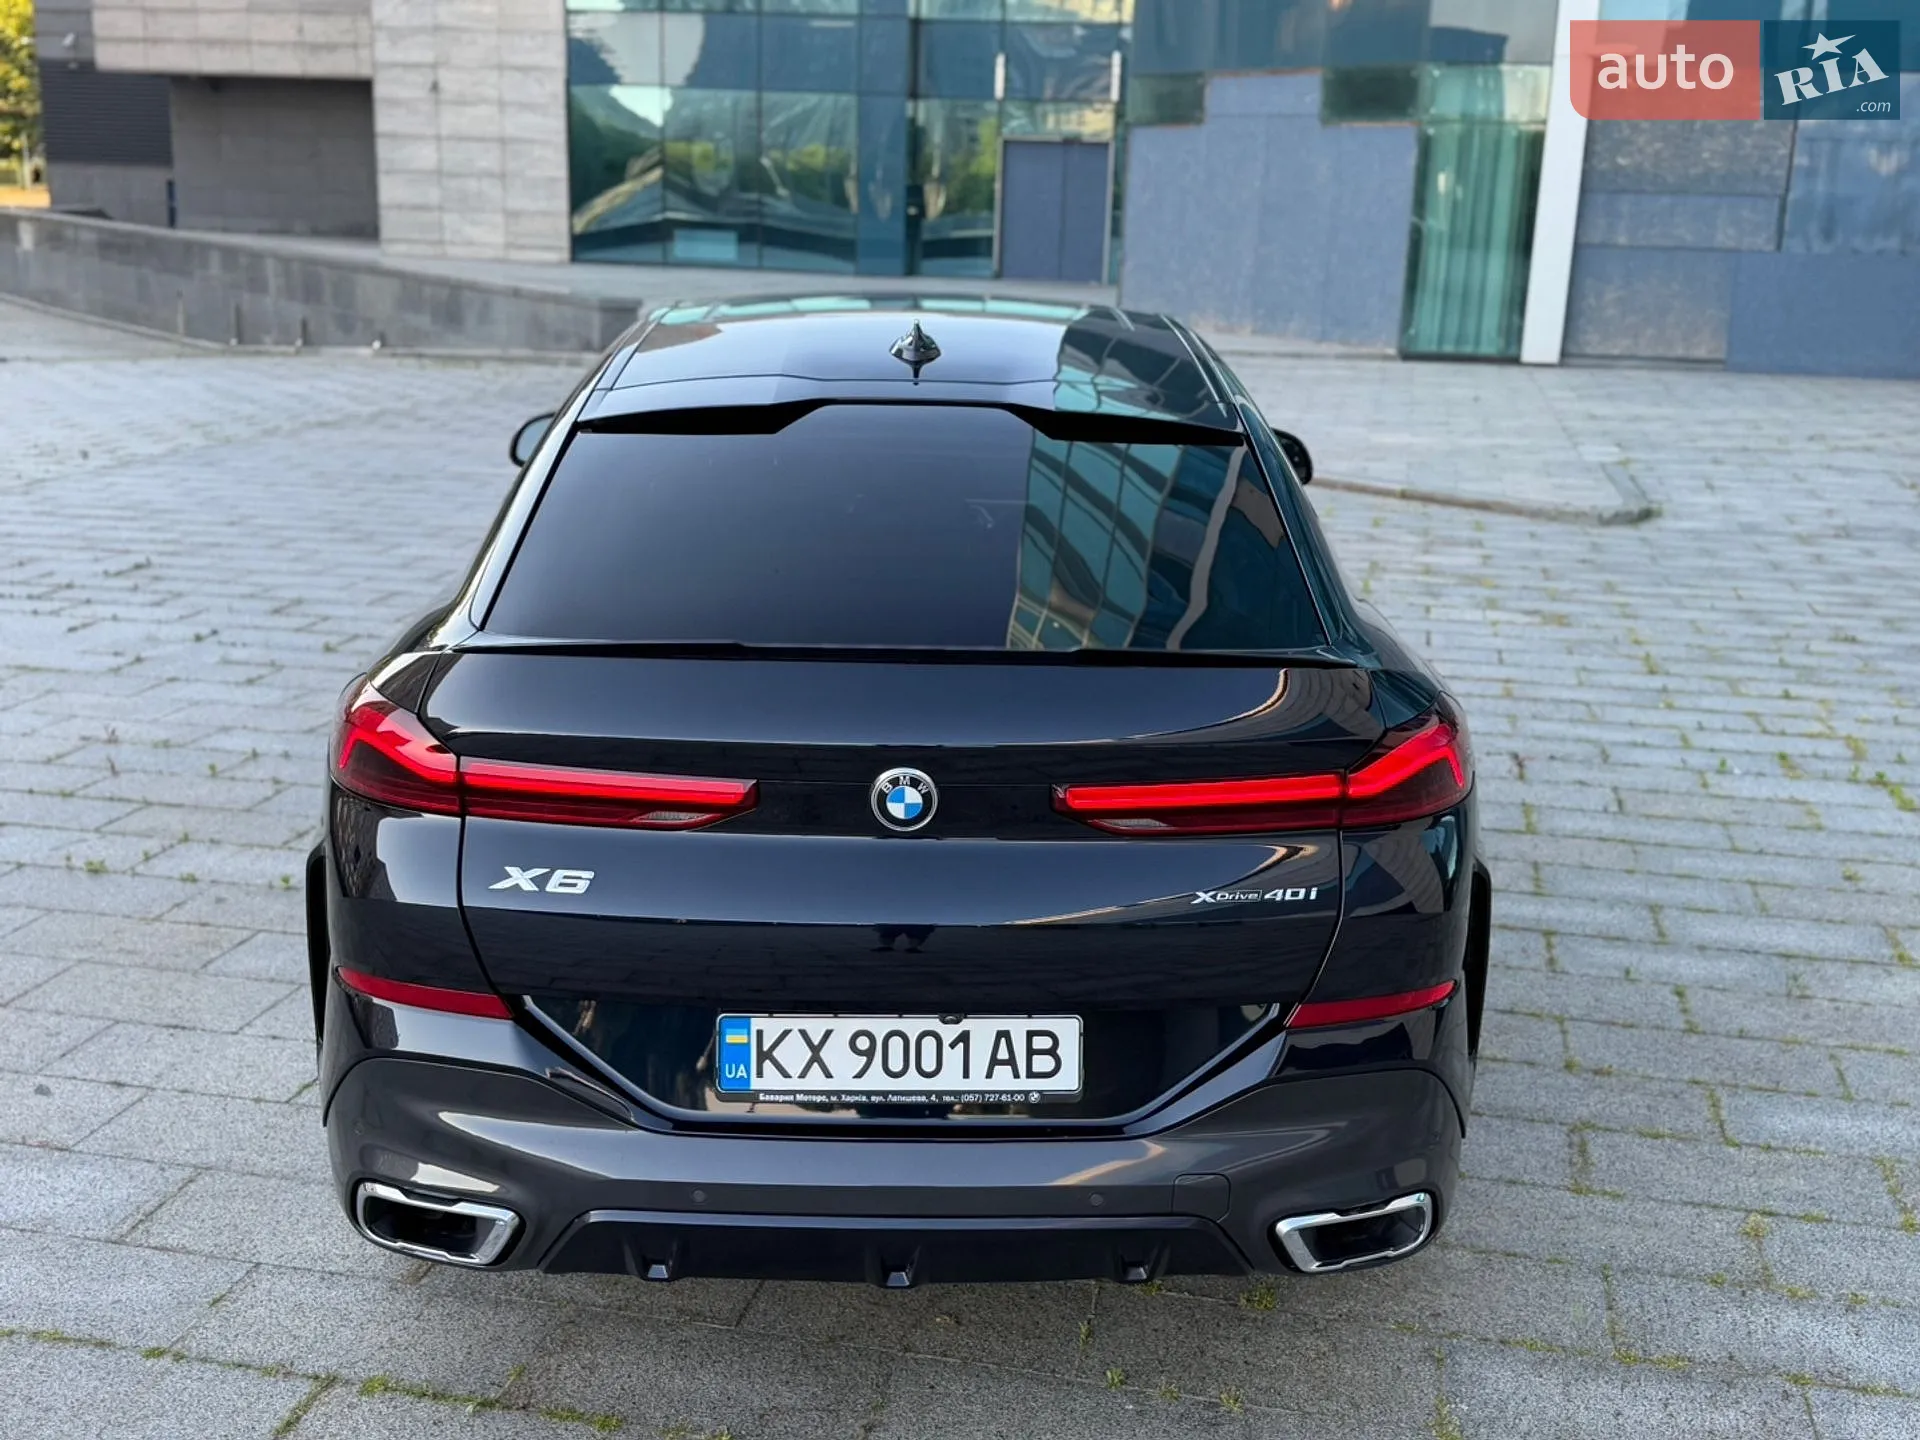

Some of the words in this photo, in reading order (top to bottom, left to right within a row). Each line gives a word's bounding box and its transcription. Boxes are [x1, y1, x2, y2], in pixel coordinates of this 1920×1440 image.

[881, 775, 930, 794] BMW
[488, 866, 595, 894] X6
[848, 1029, 970, 1079] 9001
[725, 1063, 748, 1079] UA
[961, 1093, 982, 1103] (057)
[984, 1093, 1025, 1102] 727-61-00
